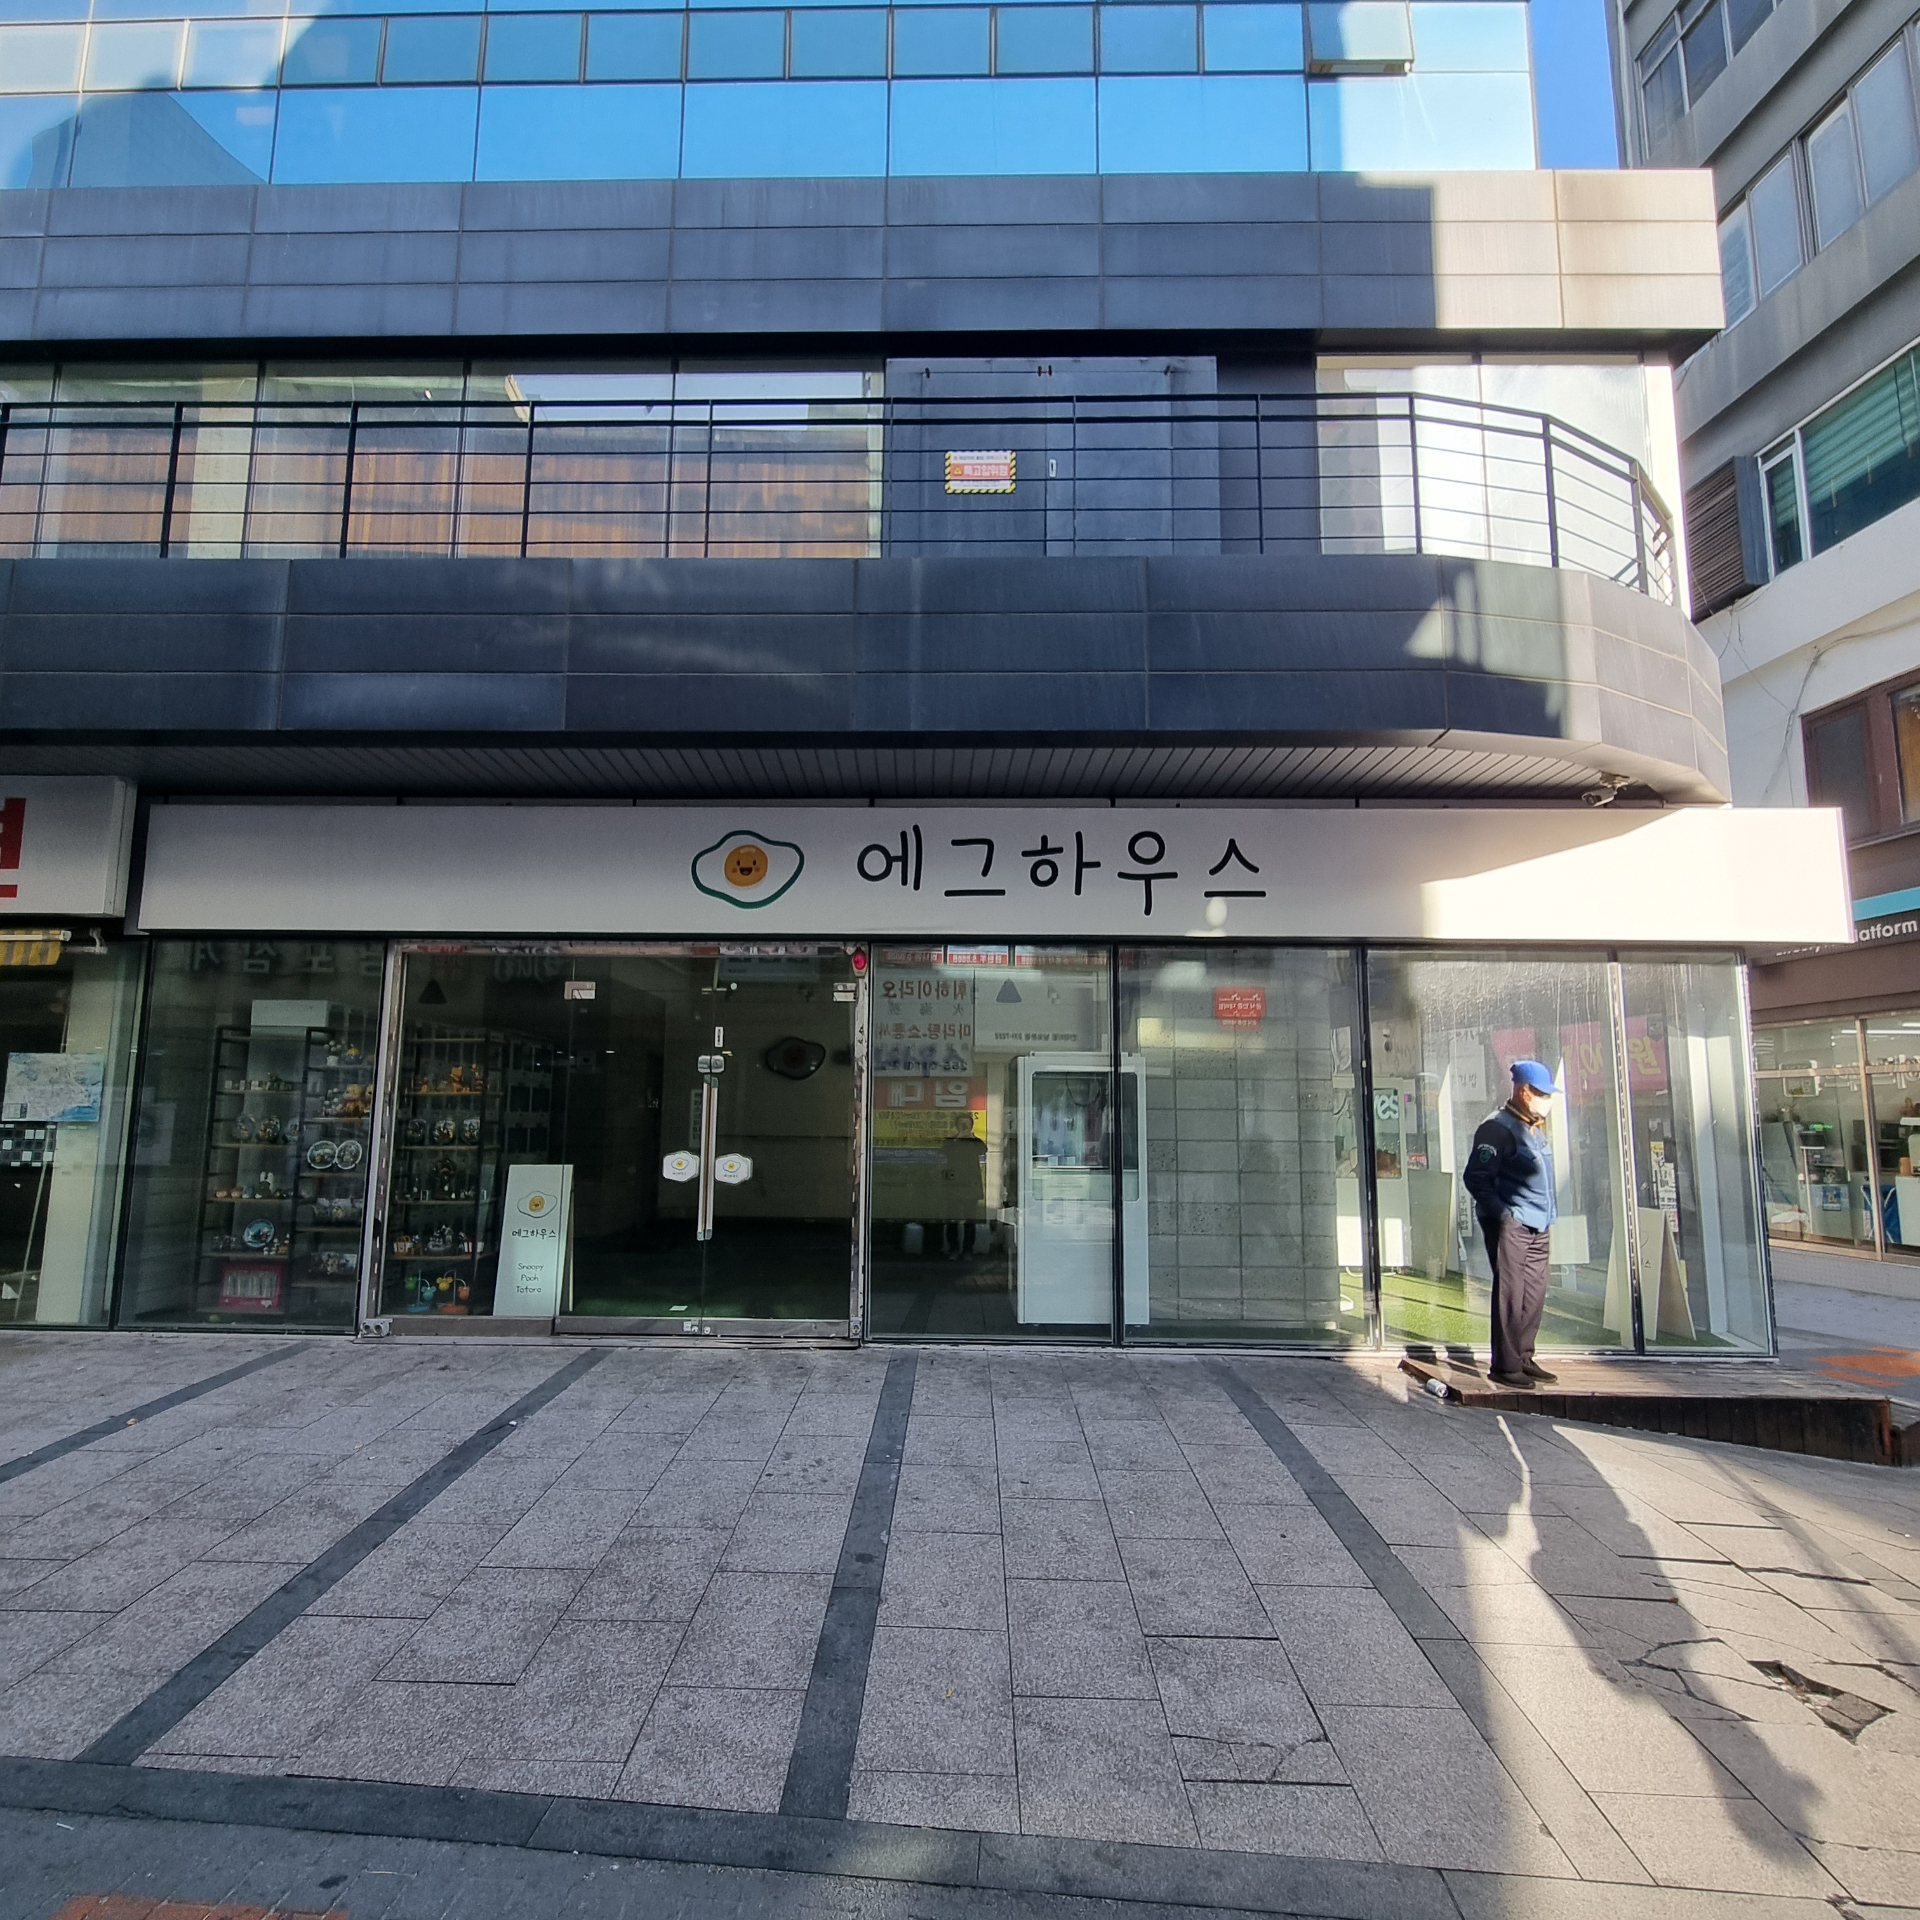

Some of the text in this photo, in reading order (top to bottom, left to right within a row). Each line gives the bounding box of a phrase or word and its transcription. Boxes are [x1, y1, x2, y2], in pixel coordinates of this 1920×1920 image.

[857, 824, 1267, 916] 에그하우스
[511, 1227, 557, 1240] 에그하우스
[517, 1262, 544, 1272] Snoopy
[520, 1273, 539, 1282] Pooh
[515, 1285, 542, 1294] Totoro
